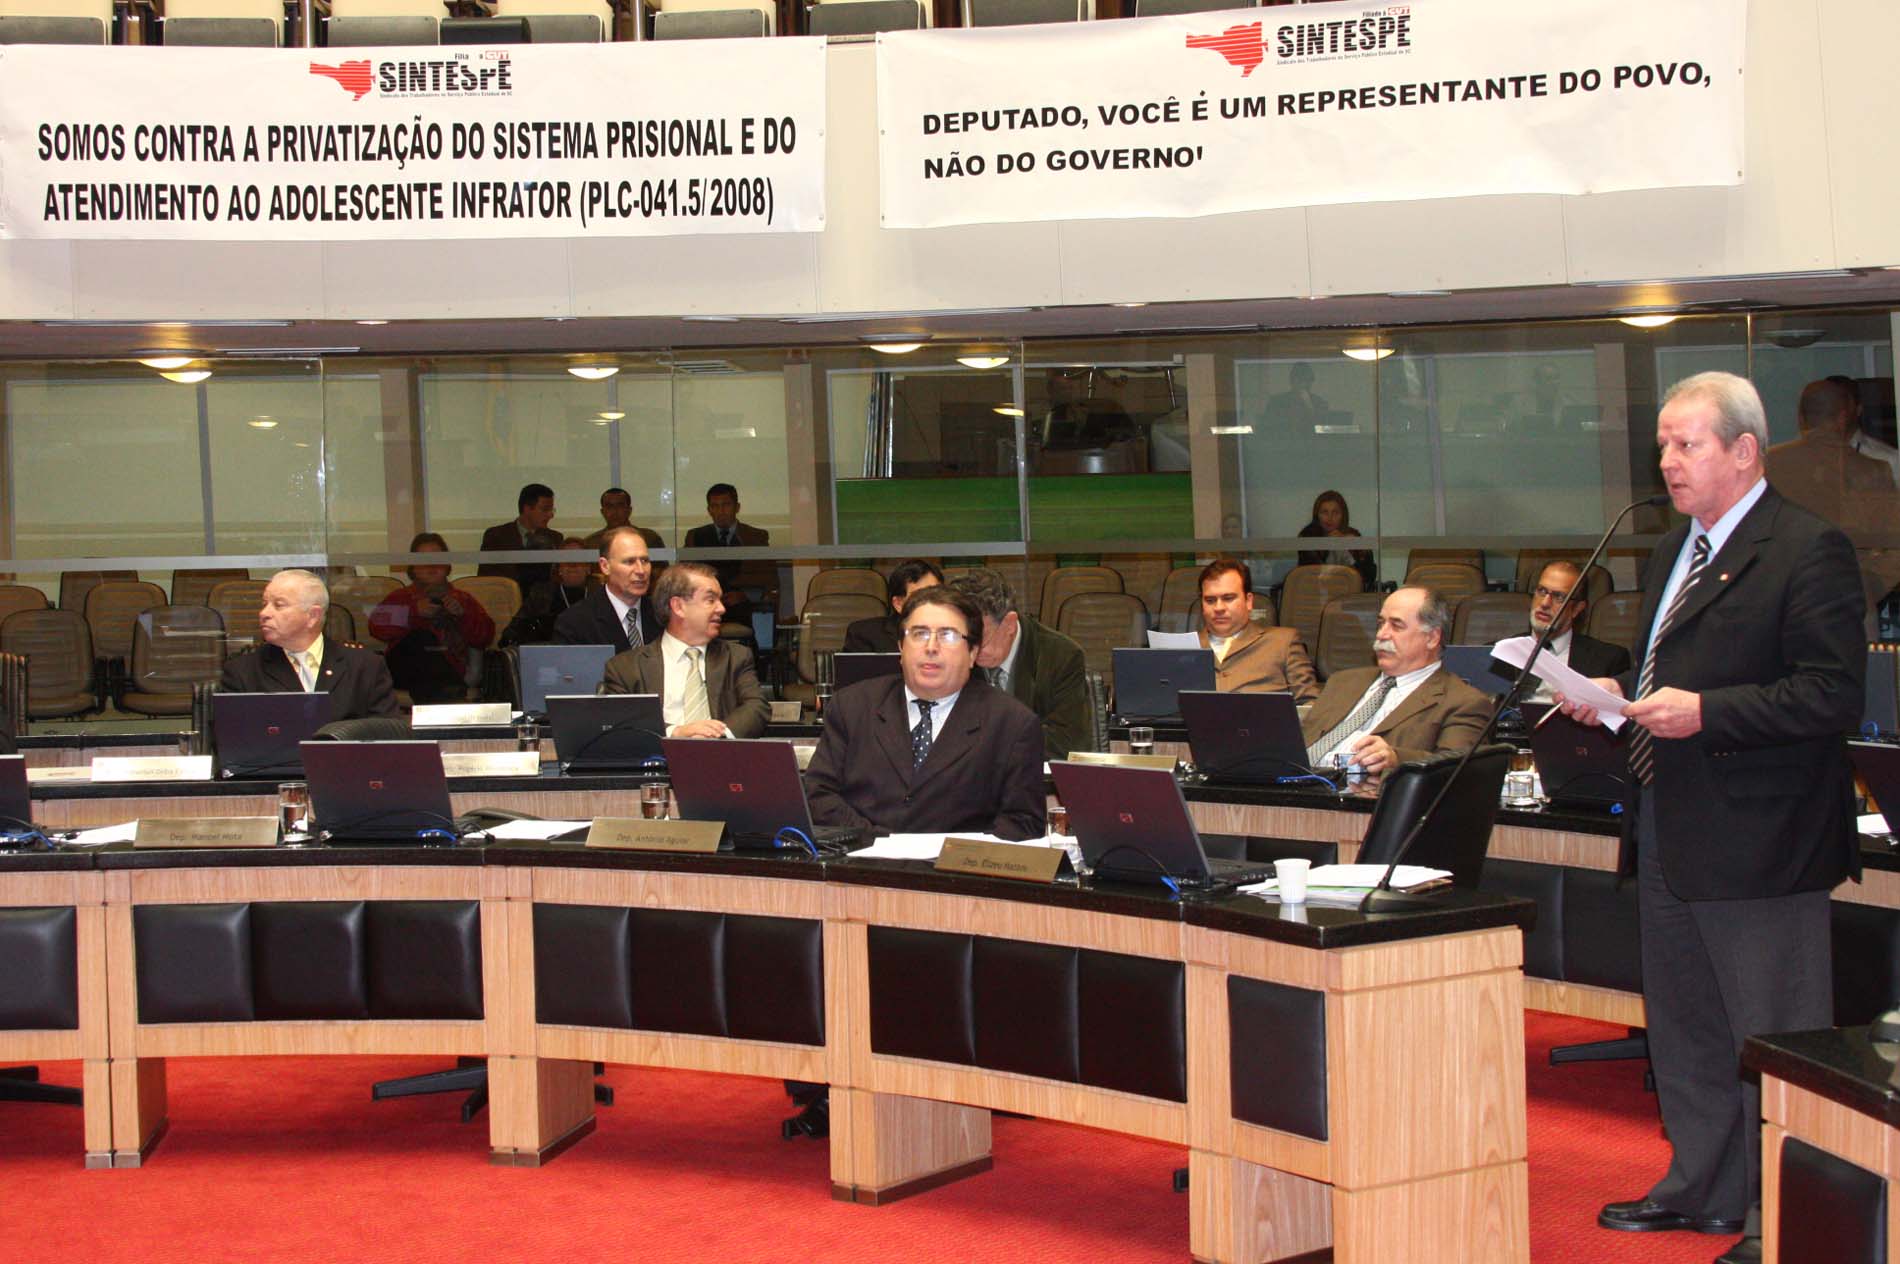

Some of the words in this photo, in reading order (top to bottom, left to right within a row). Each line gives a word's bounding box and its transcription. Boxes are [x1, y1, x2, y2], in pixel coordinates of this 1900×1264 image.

[1277, 15, 1411, 58] SINTESPE
[923, 106, 1089, 135] DEPUTADO,
[1098, 96, 1180, 126] VOCÊ
[1220, 96, 1266, 119] UM
[1278, 74, 1548, 116] REPRESENTANTE
[1559, 69, 1601, 94] DO
[1614, 62, 1711, 89] POVO,
[38, 123, 125, 161] SOMOS
[134, 124, 236, 162] CONTRA
[243, 125, 260, 162] A
[267, 115, 443, 170] PRIVATIZAÇÃO
[452, 122, 485, 160] DO
[493, 121, 599, 160] SISTEMA
[606, 118, 733, 158] PRISIONAL
[741, 118, 755, 155] E
[763, 116, 796, 154] DO
[924, 151, 985, 179] NÃO
[997, 152, 1035, 174] DO
[43, 183, 219, 222] ATENDIMENTO
[227, 184, 261, 221] AO
[268, 182, 444, 222] ADOLESCENTE
[452, 181, 572, 219] INFRATOR
[580, 177, 774, 228] (PLC-041.5/2008)
